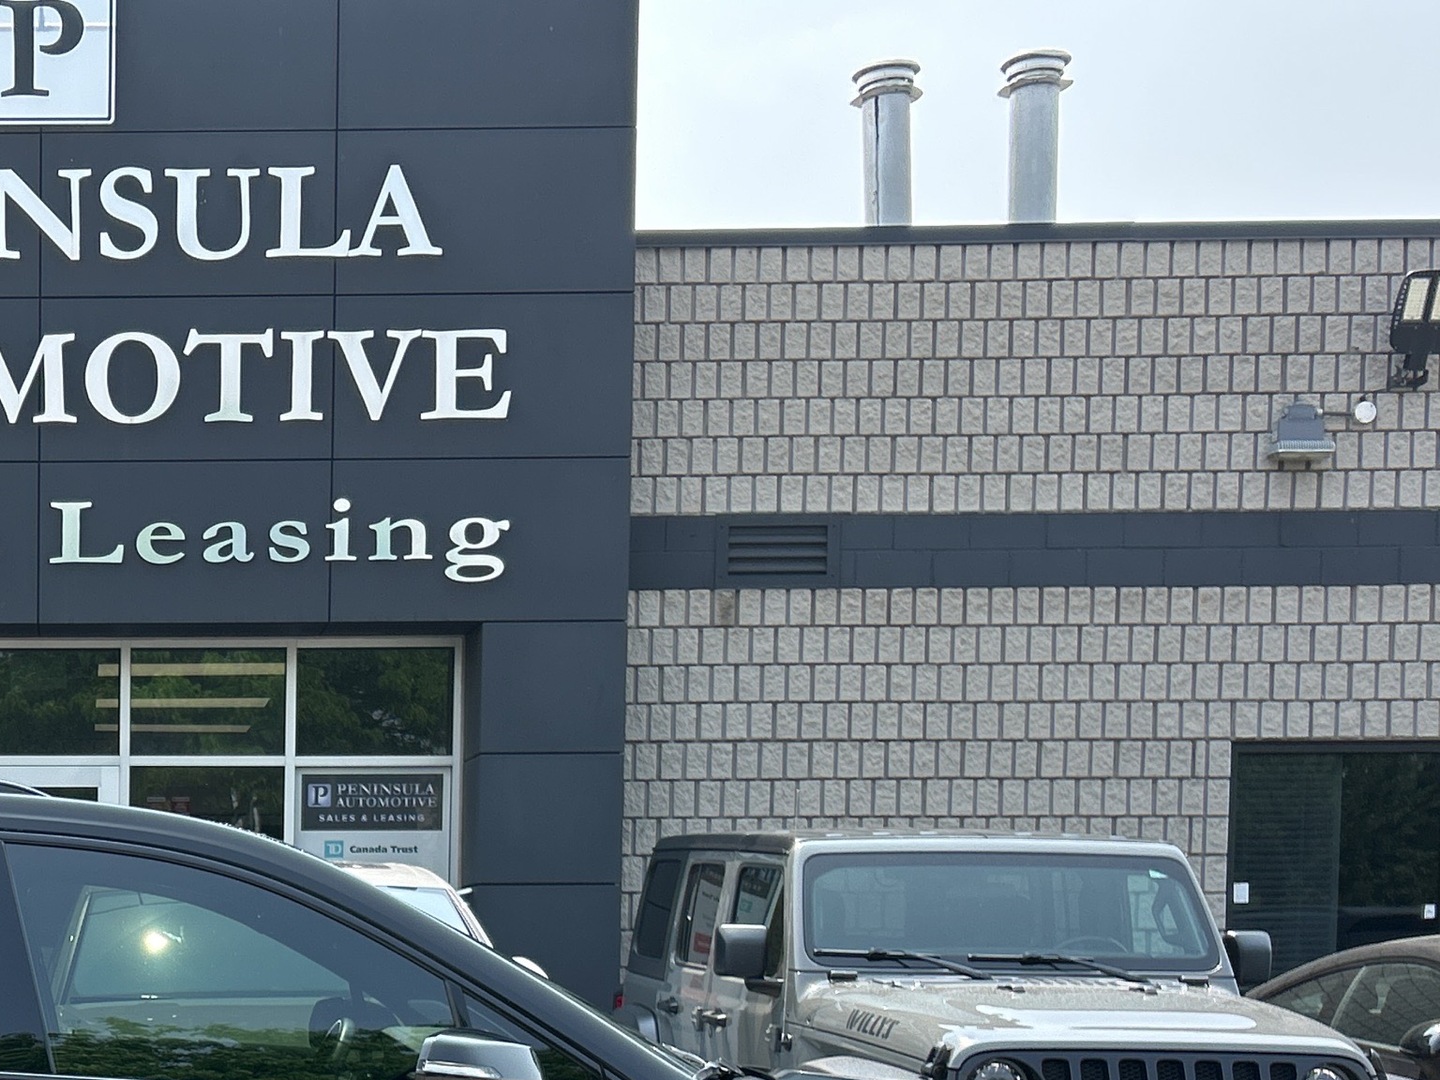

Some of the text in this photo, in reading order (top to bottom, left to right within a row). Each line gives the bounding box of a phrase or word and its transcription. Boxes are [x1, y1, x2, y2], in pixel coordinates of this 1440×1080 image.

[48, 497, 512, 584] Leasing
[336, 783, 435, 795] PENINSULA
[312, 785, 329, 806] P
[336, 796, 438, 808] AUTOMOTIVE
[318, 814, 426, 823] SALES & LEASING
[326, 842, 343, 856] TD
[349, 845, 419, 854] Canada Trust
